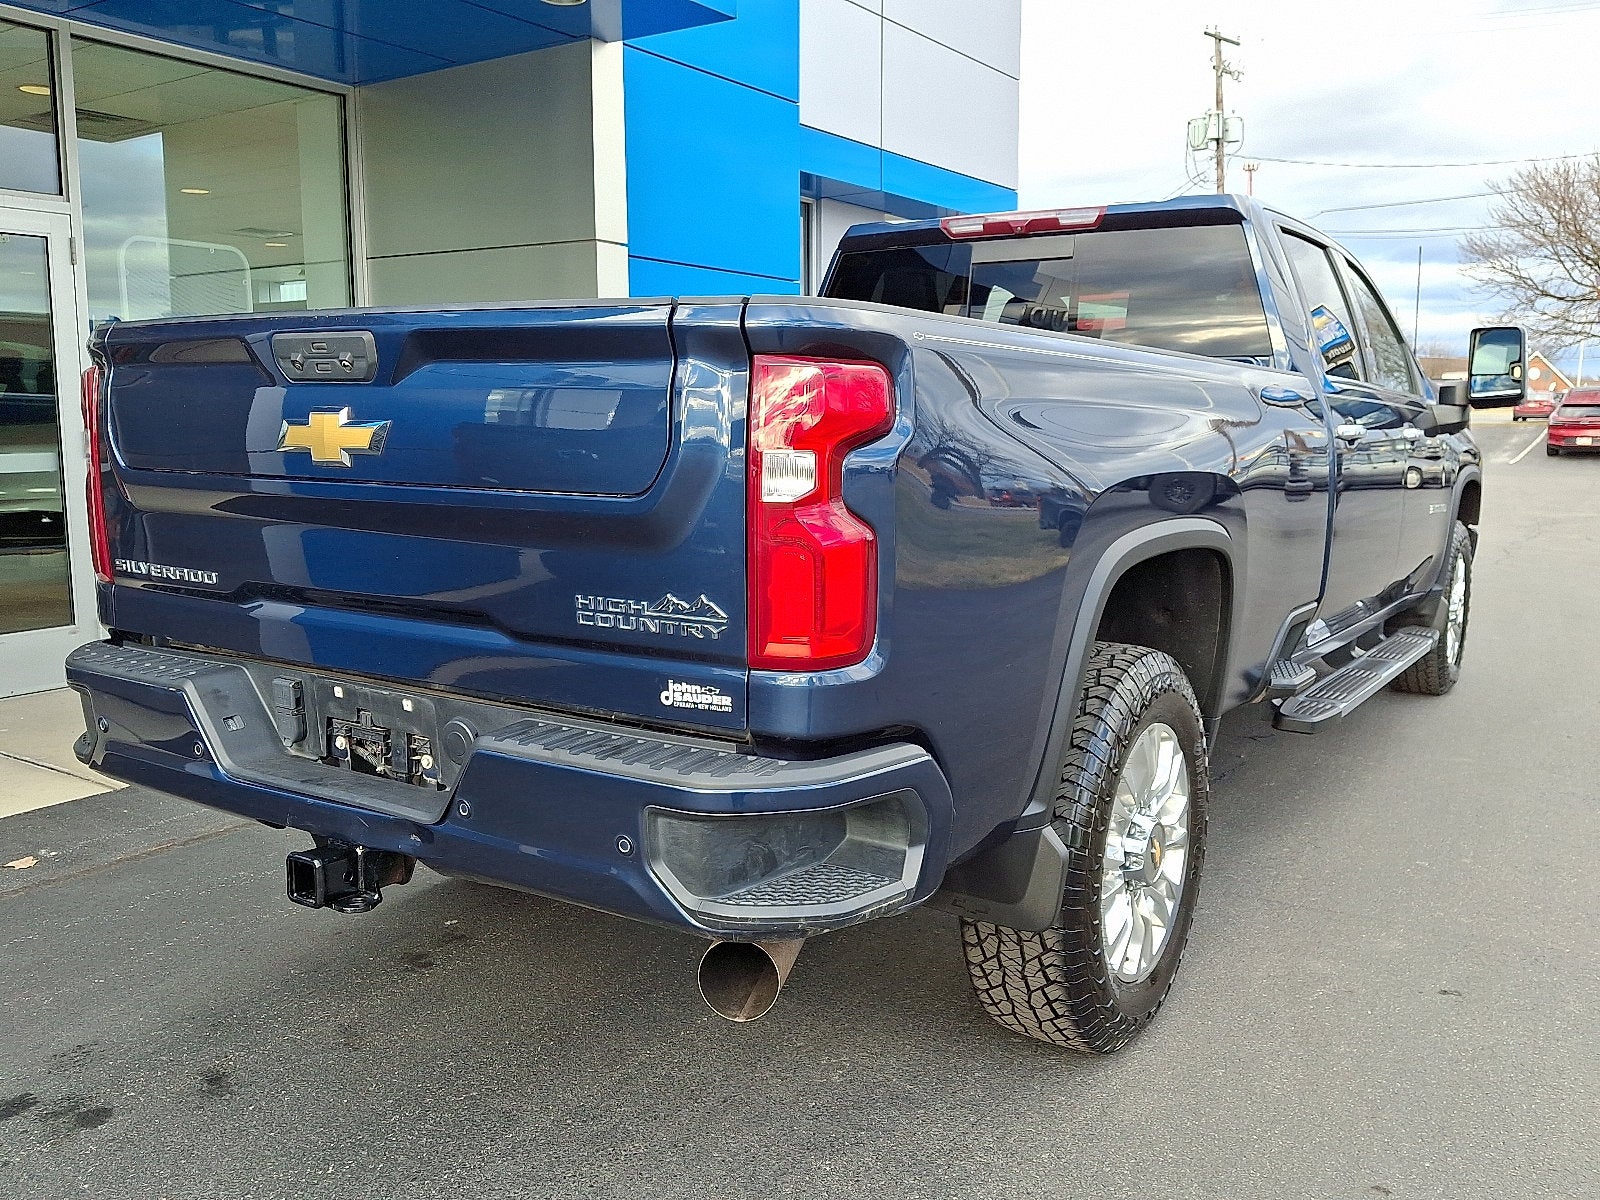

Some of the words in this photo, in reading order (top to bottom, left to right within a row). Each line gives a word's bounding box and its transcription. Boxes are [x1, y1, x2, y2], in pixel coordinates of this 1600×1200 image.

[115, 559, 218, 584] SILVERADO
[575, 594, 650, 616] HIGH
[576, 611, 728, 639] COUNTRY
[673, 691, 732, 706] SAUDER
